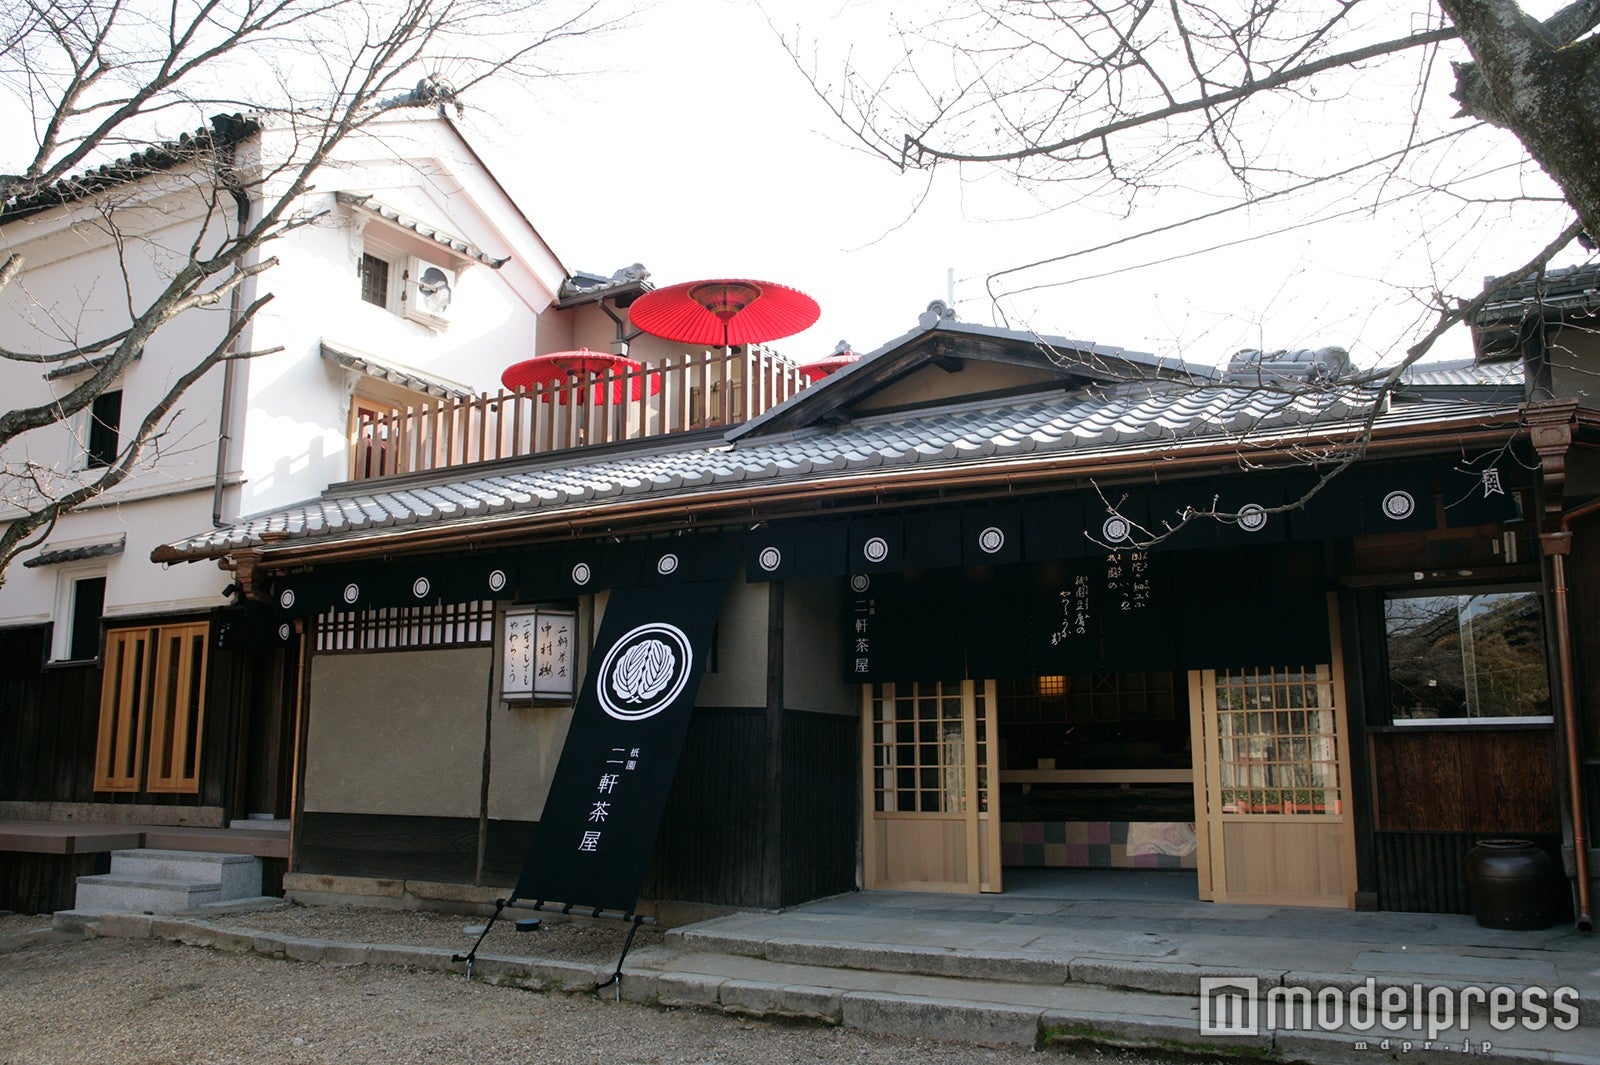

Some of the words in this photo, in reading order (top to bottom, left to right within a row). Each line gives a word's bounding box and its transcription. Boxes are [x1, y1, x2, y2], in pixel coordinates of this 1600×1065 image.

[557, 625, 569, 678] 二軒茶屋
[854, 599, 870, 673] 二軒茶屋
[625, 747, 641, 771] 祇園
[577, 747, 626, 852] 二軒茶屋
